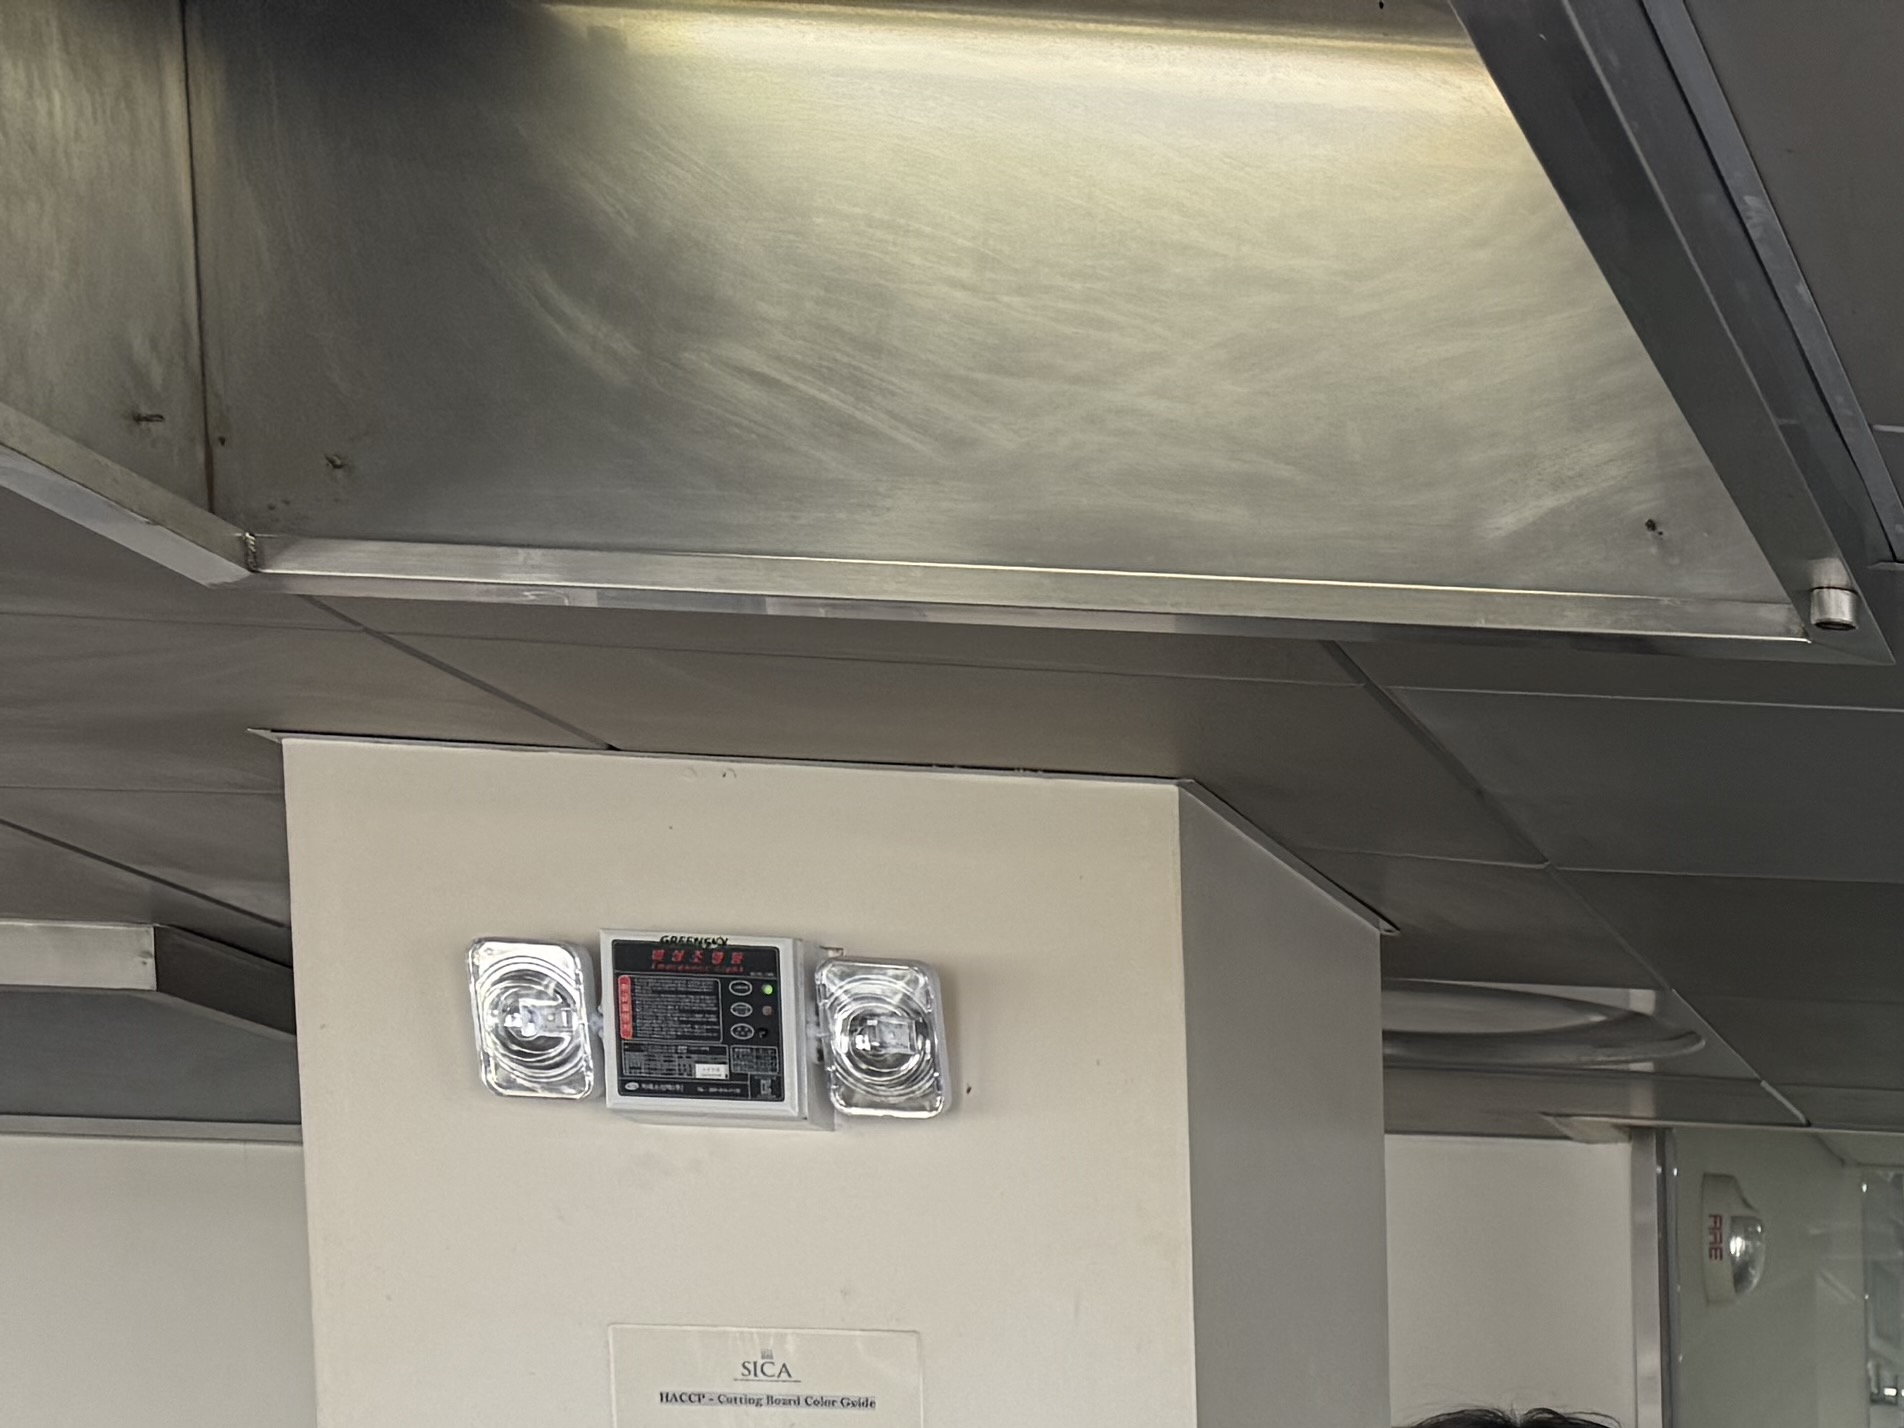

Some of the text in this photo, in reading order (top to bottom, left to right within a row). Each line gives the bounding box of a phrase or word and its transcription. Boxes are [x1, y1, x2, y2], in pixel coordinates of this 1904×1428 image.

[741, 1360, 792, 1379] SICA
[659, 1391, 705, 1406] HACCP
[717, 1394, 763, 1409] Cutting
[766, 1395, 800, 1408] Board
[804, 1395, 838, 1408] Color
[840, 1396, 876, 1409] Guide
